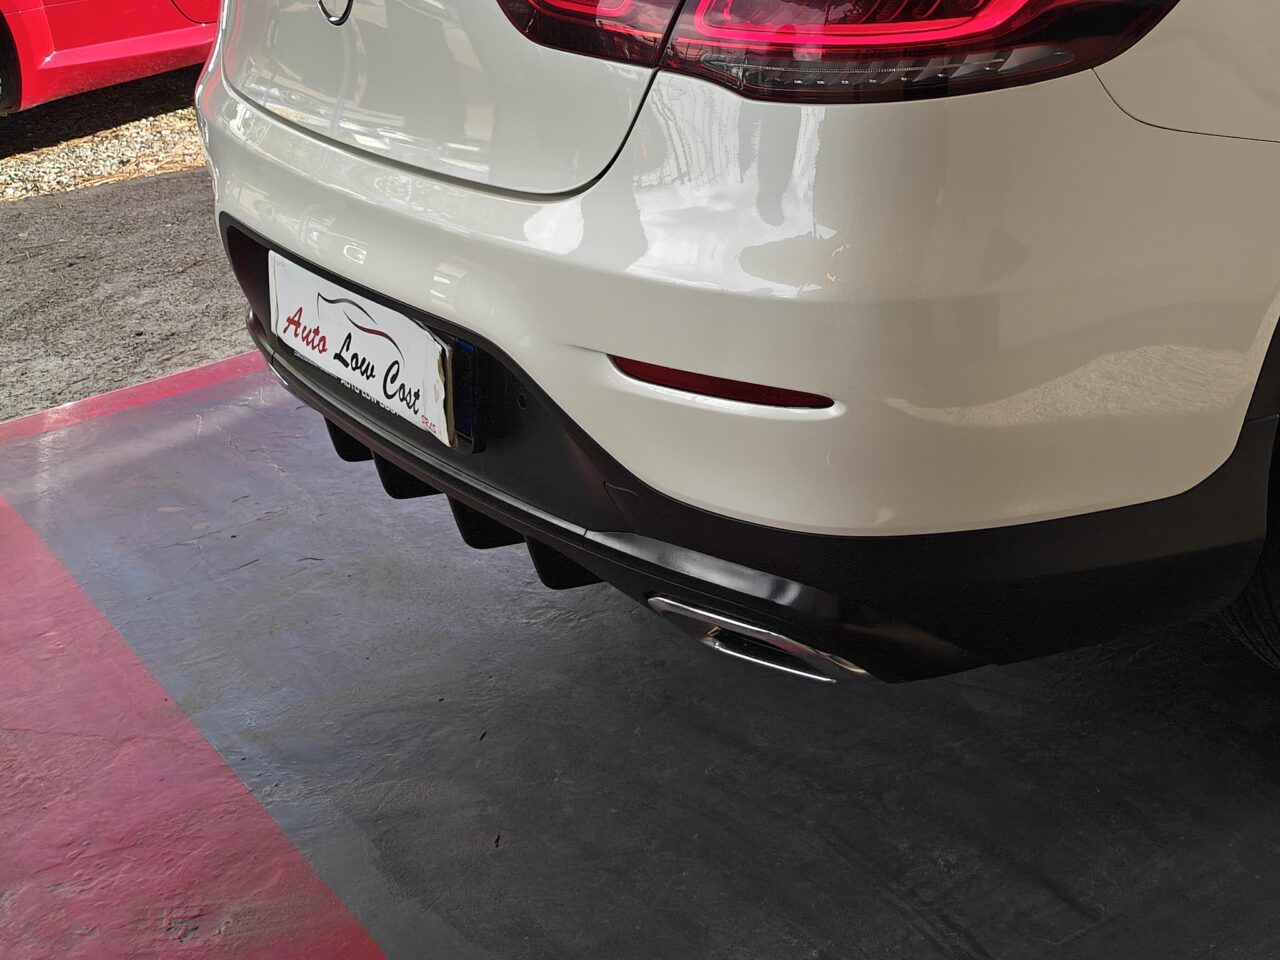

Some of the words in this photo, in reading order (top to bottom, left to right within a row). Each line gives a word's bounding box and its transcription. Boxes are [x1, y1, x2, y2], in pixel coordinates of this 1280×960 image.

[282, 306, 329, 355] Auto
[333, 332, 376, 381] Low
[382, 359, 421, 416] Cost
